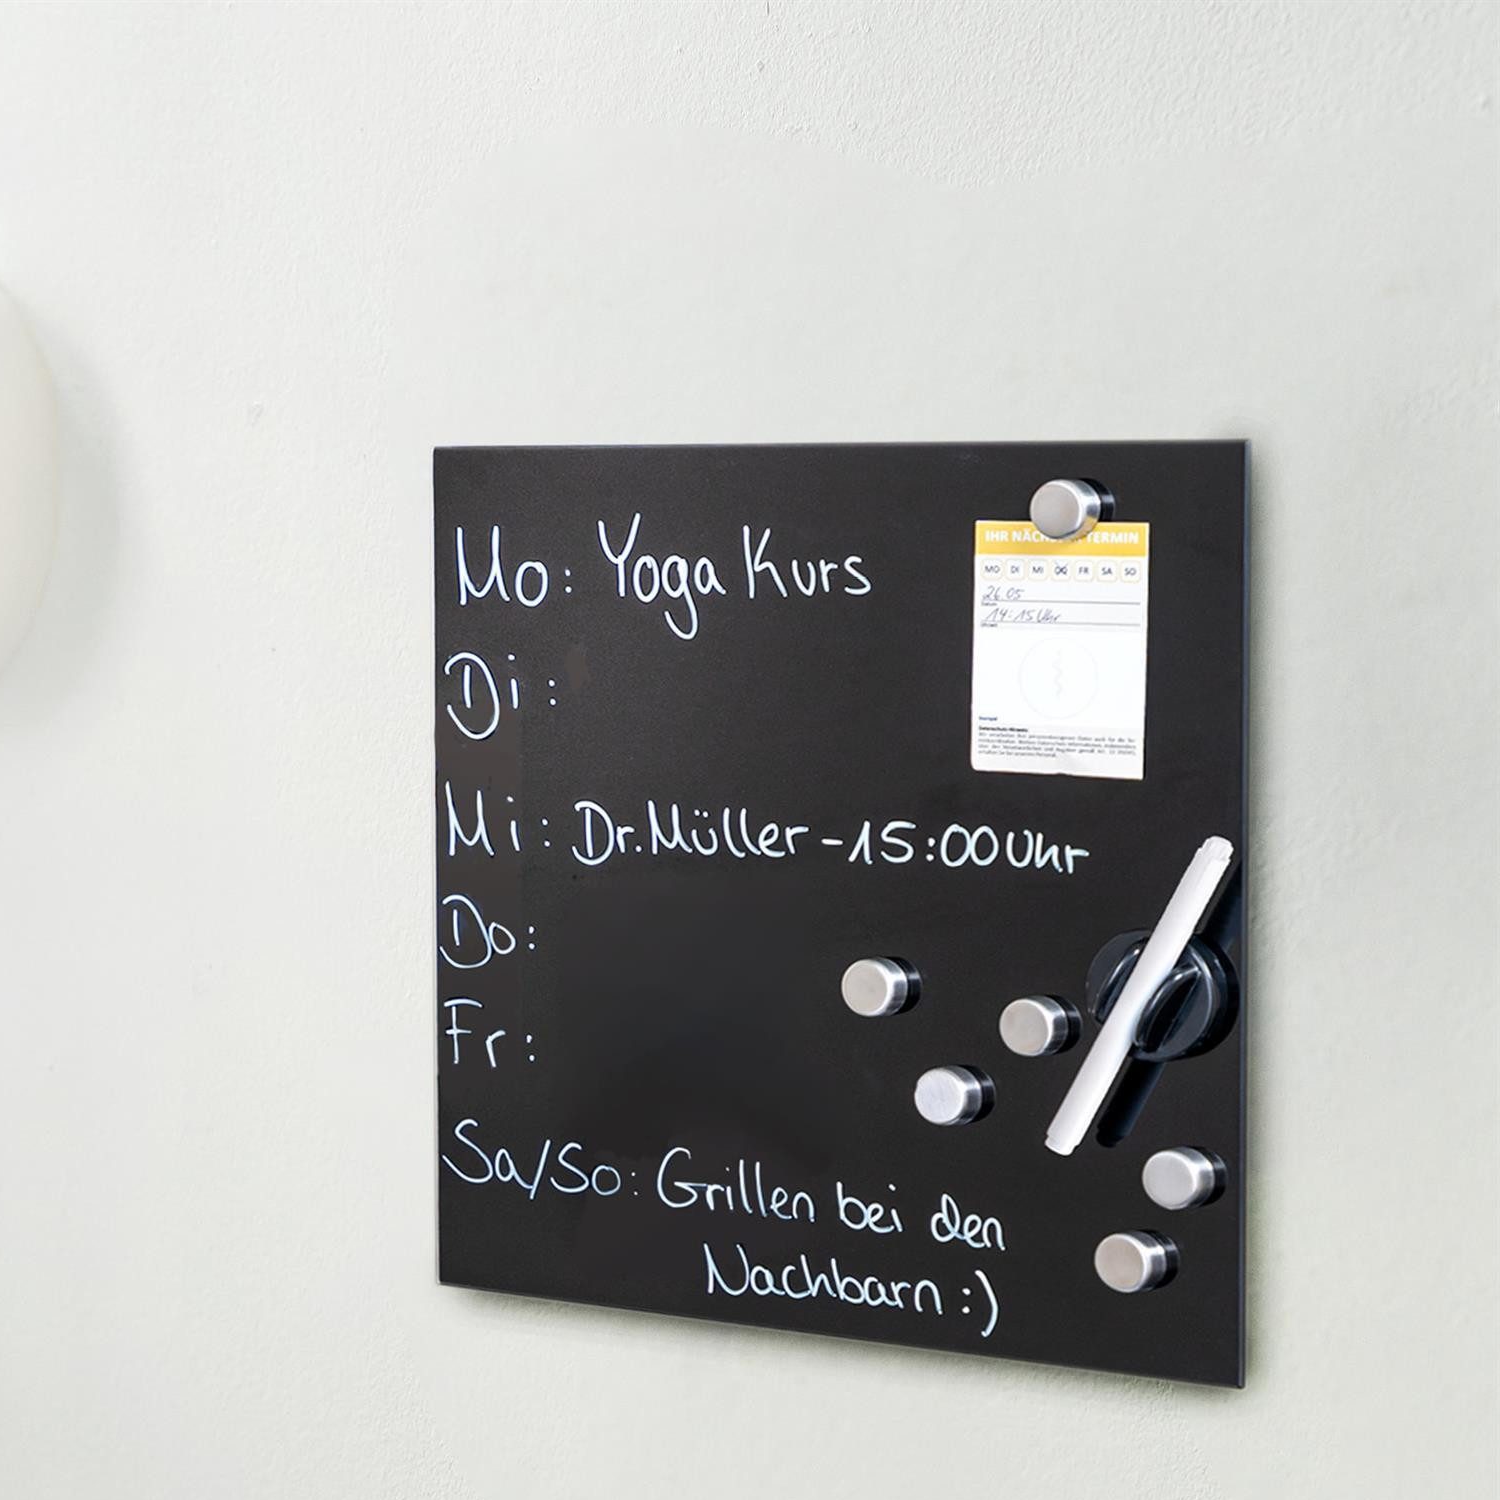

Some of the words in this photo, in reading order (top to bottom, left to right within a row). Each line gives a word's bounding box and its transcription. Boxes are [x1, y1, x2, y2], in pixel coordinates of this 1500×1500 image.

[984, 530, 1009, 542] IHR
[1086, 531, 1139, 544] TERMIN
[984, 565, 1001, 574] MO
[1010, 565, 1020, 574] DI
[1032, 566, 1044, 574] MI
[1078, 566, 1090, 575] FR
[1101, 567, 1113, 576] SA
[1124, 568, 1137, 577] SO
[456, 525, 573, 607] Mo:
[598, 512, 727, 640] Yoga
[743, 524, 872, 598] Kurs
[656, 1147, 815, 1223] Grillen
[836, 1181, 903, 1233] bei
[931, 1193, 1006, 1251] den
[704, 1243, 943, 1316] Nachbarn
